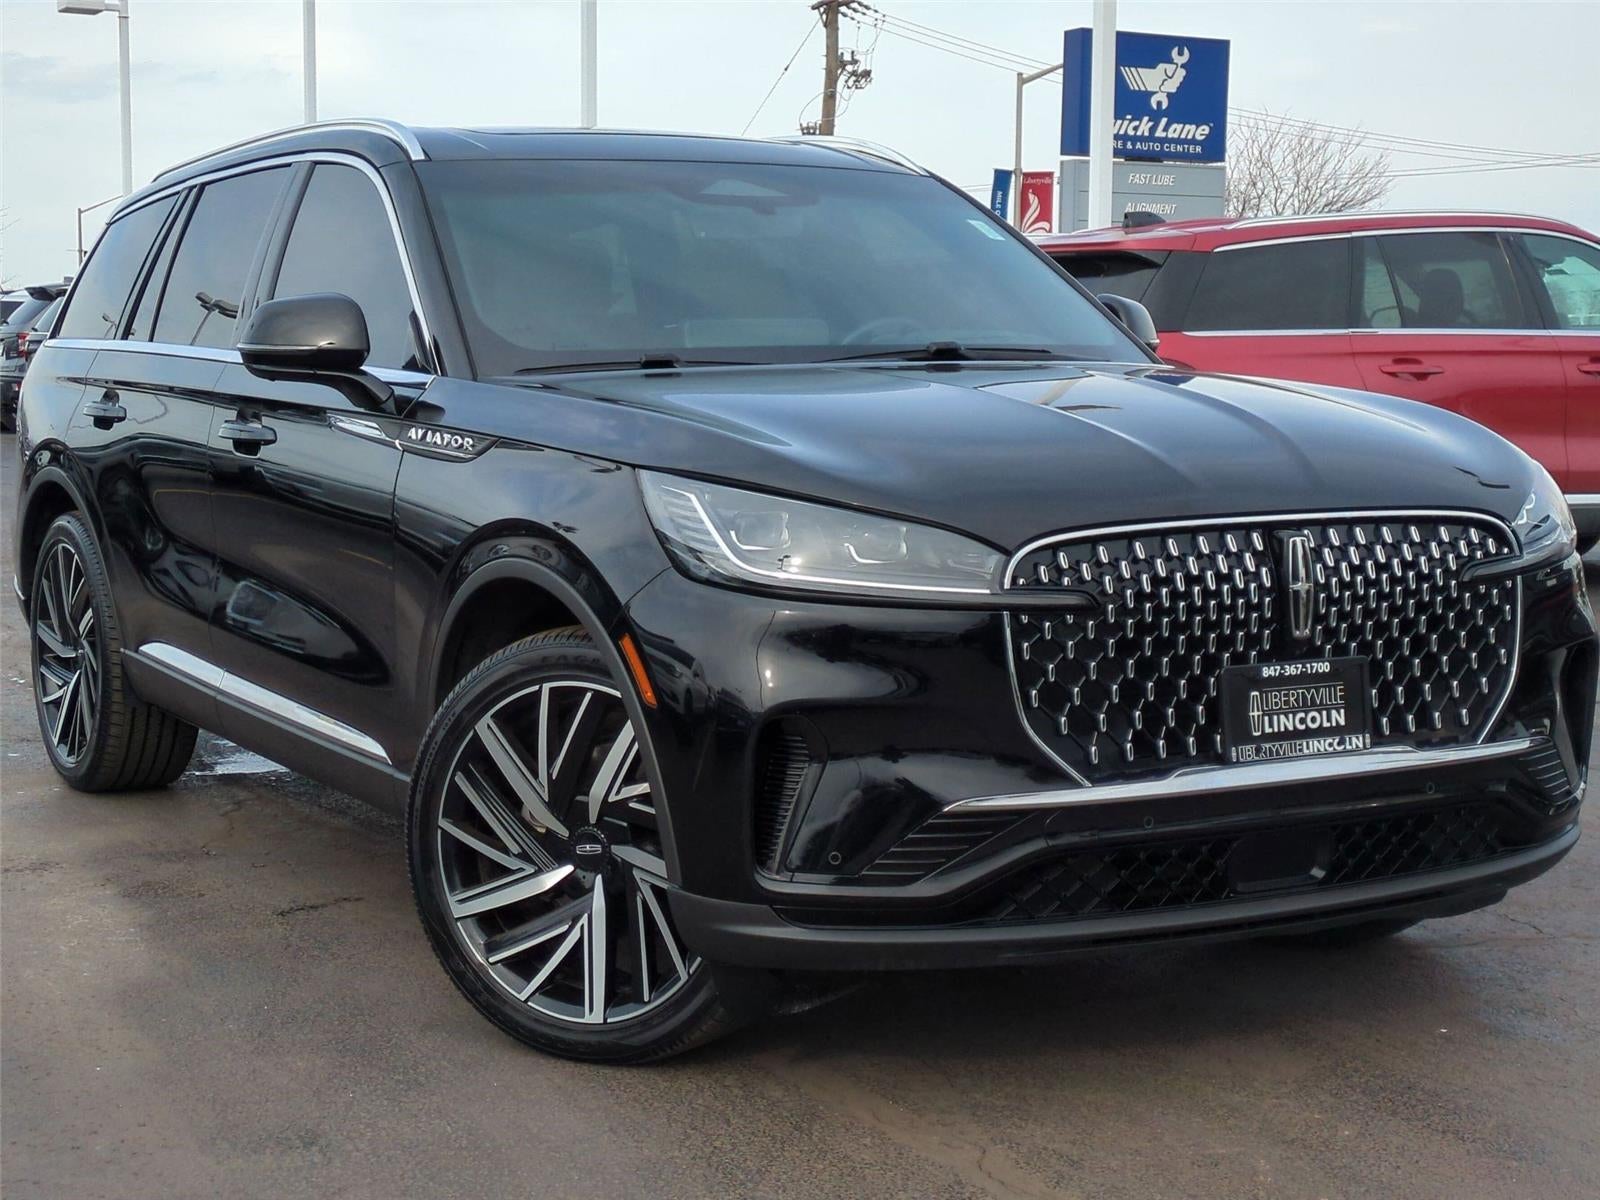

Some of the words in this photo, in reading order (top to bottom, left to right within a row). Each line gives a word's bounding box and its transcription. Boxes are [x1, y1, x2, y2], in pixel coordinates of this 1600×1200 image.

[1113, 115, 1154, 136] uick
[1154, 117, 1210, 140] Lane
[1112, 140, 1123, 149] RE
[1126, 141, 1133, 149] &
[1136, 142, 1161, 151] AUTO
[1163, 143, 1203, 154] CENTER
[1128, 173, 1152, 185] FAST
[1152, 174, 1176, 186] LUBE
[1124, 202, 1177, 215] ALIGNMENT
[408, 427, 474, 451] AVIATOR
[1262, 661, 1331, 678] 847-367-1700
[1263, 685, 1345, 710] LIBERTYVILLE
[1264, 709, 1346, 734] LINCOLN
